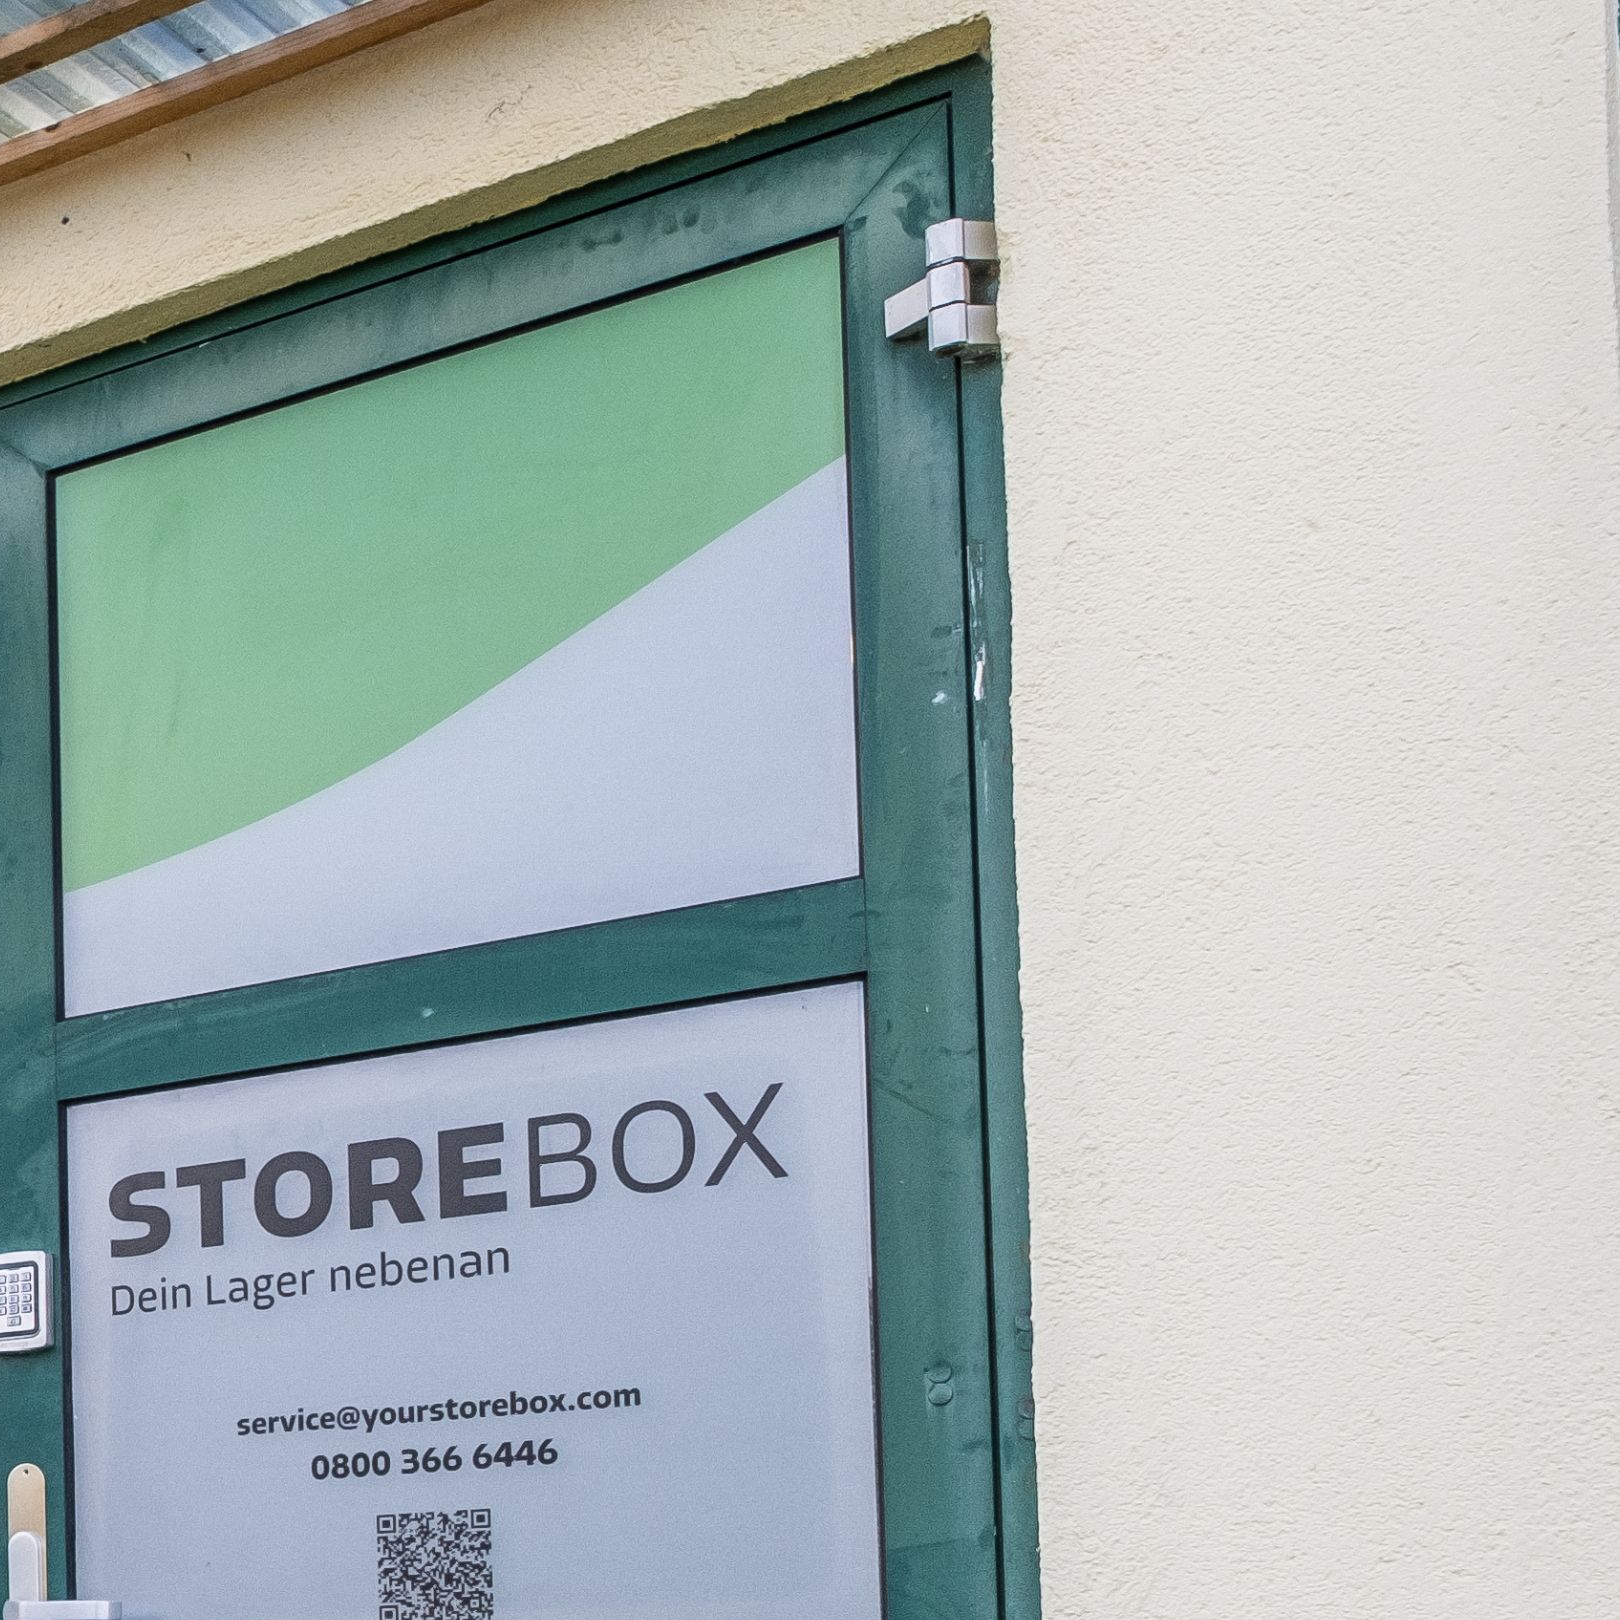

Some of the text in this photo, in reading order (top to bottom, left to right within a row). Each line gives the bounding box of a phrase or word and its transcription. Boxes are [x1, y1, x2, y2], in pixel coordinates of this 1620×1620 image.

[108, 1082, 790, 1259] STOREBOX
[111, 1246, 511, 1316] Dein Lager nebenan
[236, 1387, 642, 1436] service@yourstorebox.com
[310, 1438, 559, 1480] 0800 366 6446
